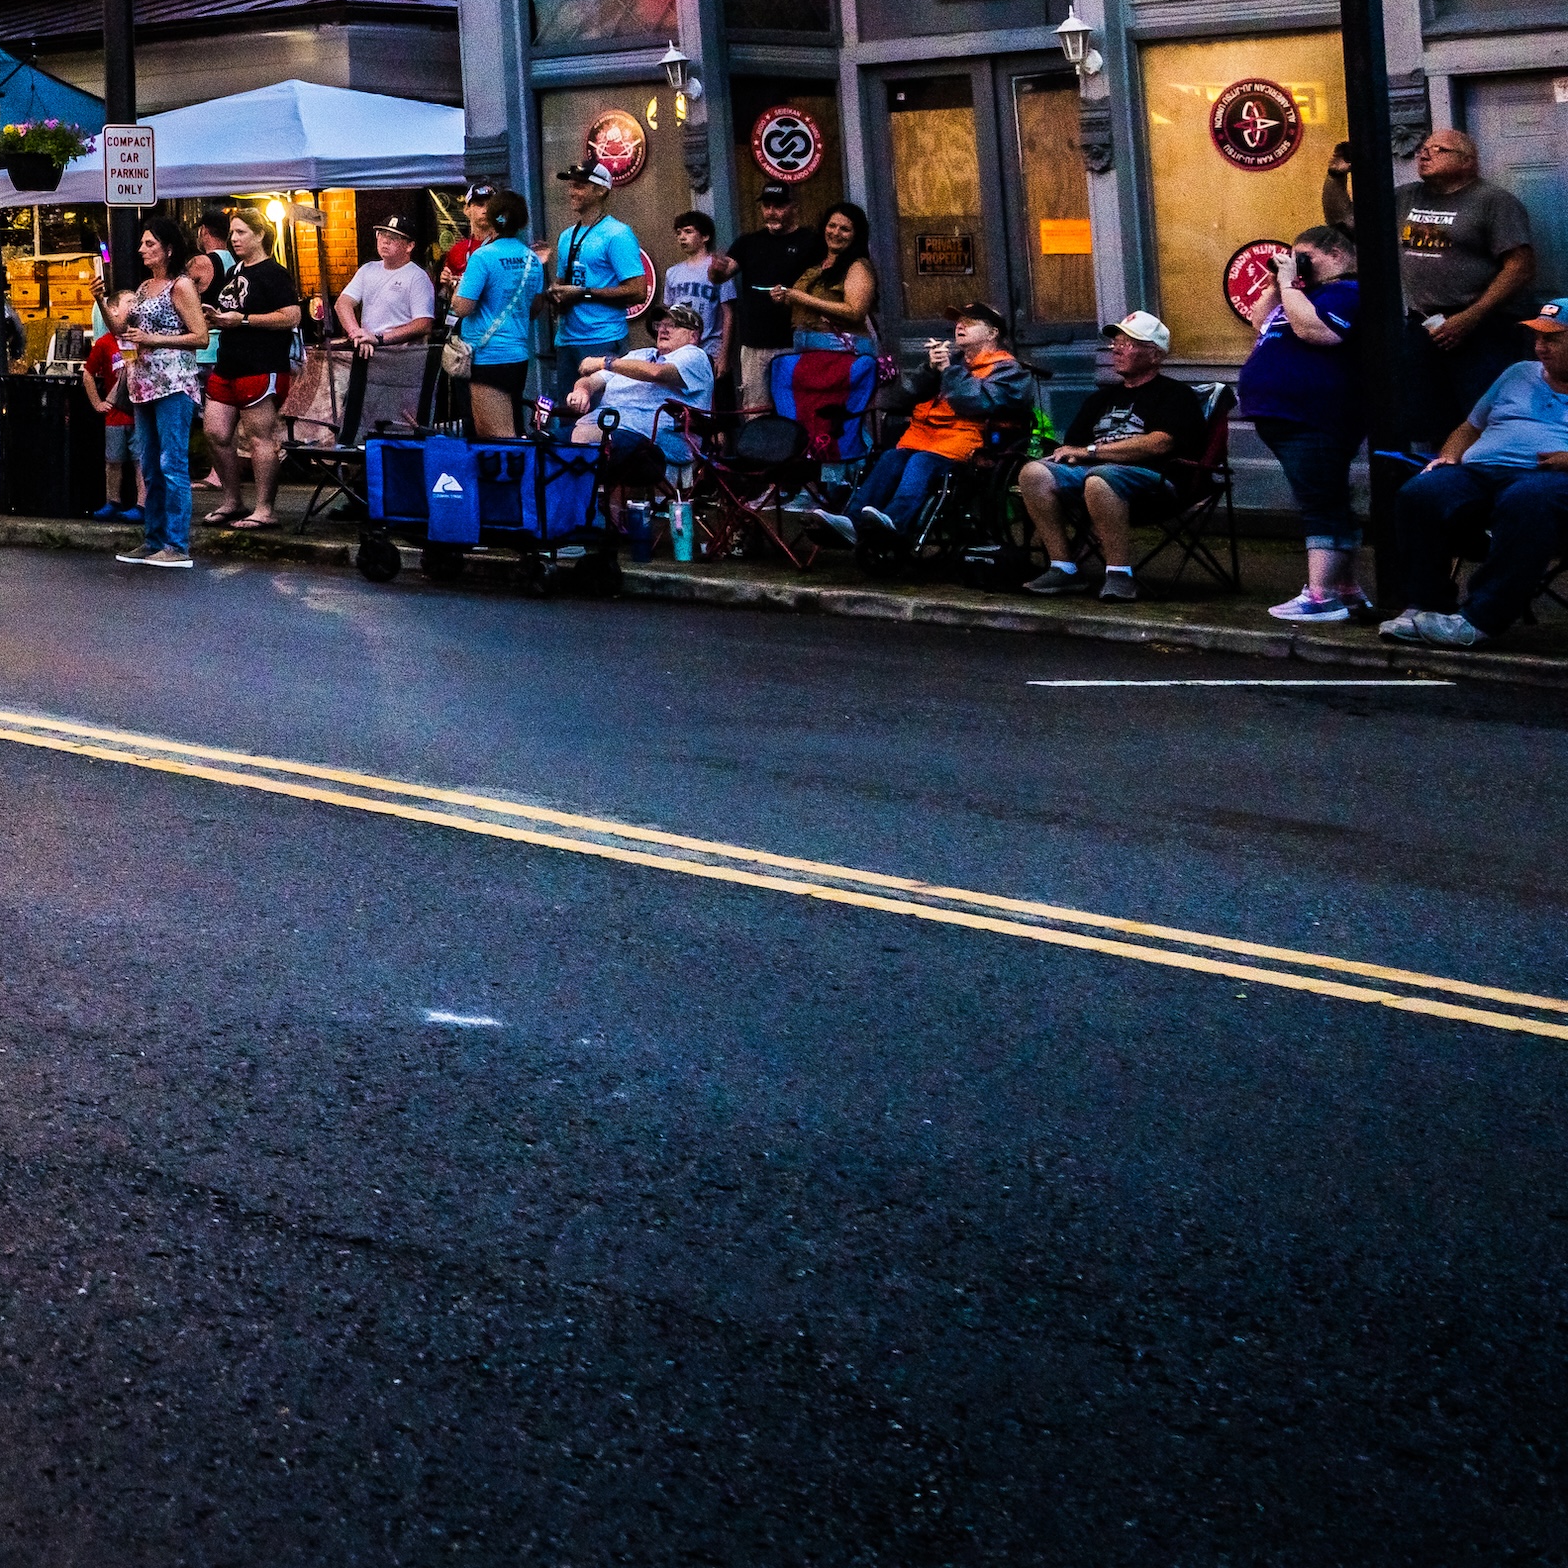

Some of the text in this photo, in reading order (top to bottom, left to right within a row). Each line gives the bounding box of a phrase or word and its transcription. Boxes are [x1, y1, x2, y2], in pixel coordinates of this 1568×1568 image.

[1214, 83, 1297, 129] ALL AMERICAN JU-JITSU UNION
[107, 136, 151, 147] COMPACT
[120, 152, 139, 163] CAR
[1223, 143, 1256, 165] JU-JITSU
[110, 168, 149, 179] PARKING
[764, 162, 793, 180] AMERICAN
[793, 169, 810, 181] JUDO
[117, 184, 143, 195] ONLY
[1406, 211, 1454, 225] MUSEUM
[925, 238, 963, 252] PRIVATE
[1253, 244, 1277, 255] WITH
[920, 251, 969, 265] PROPERTY
